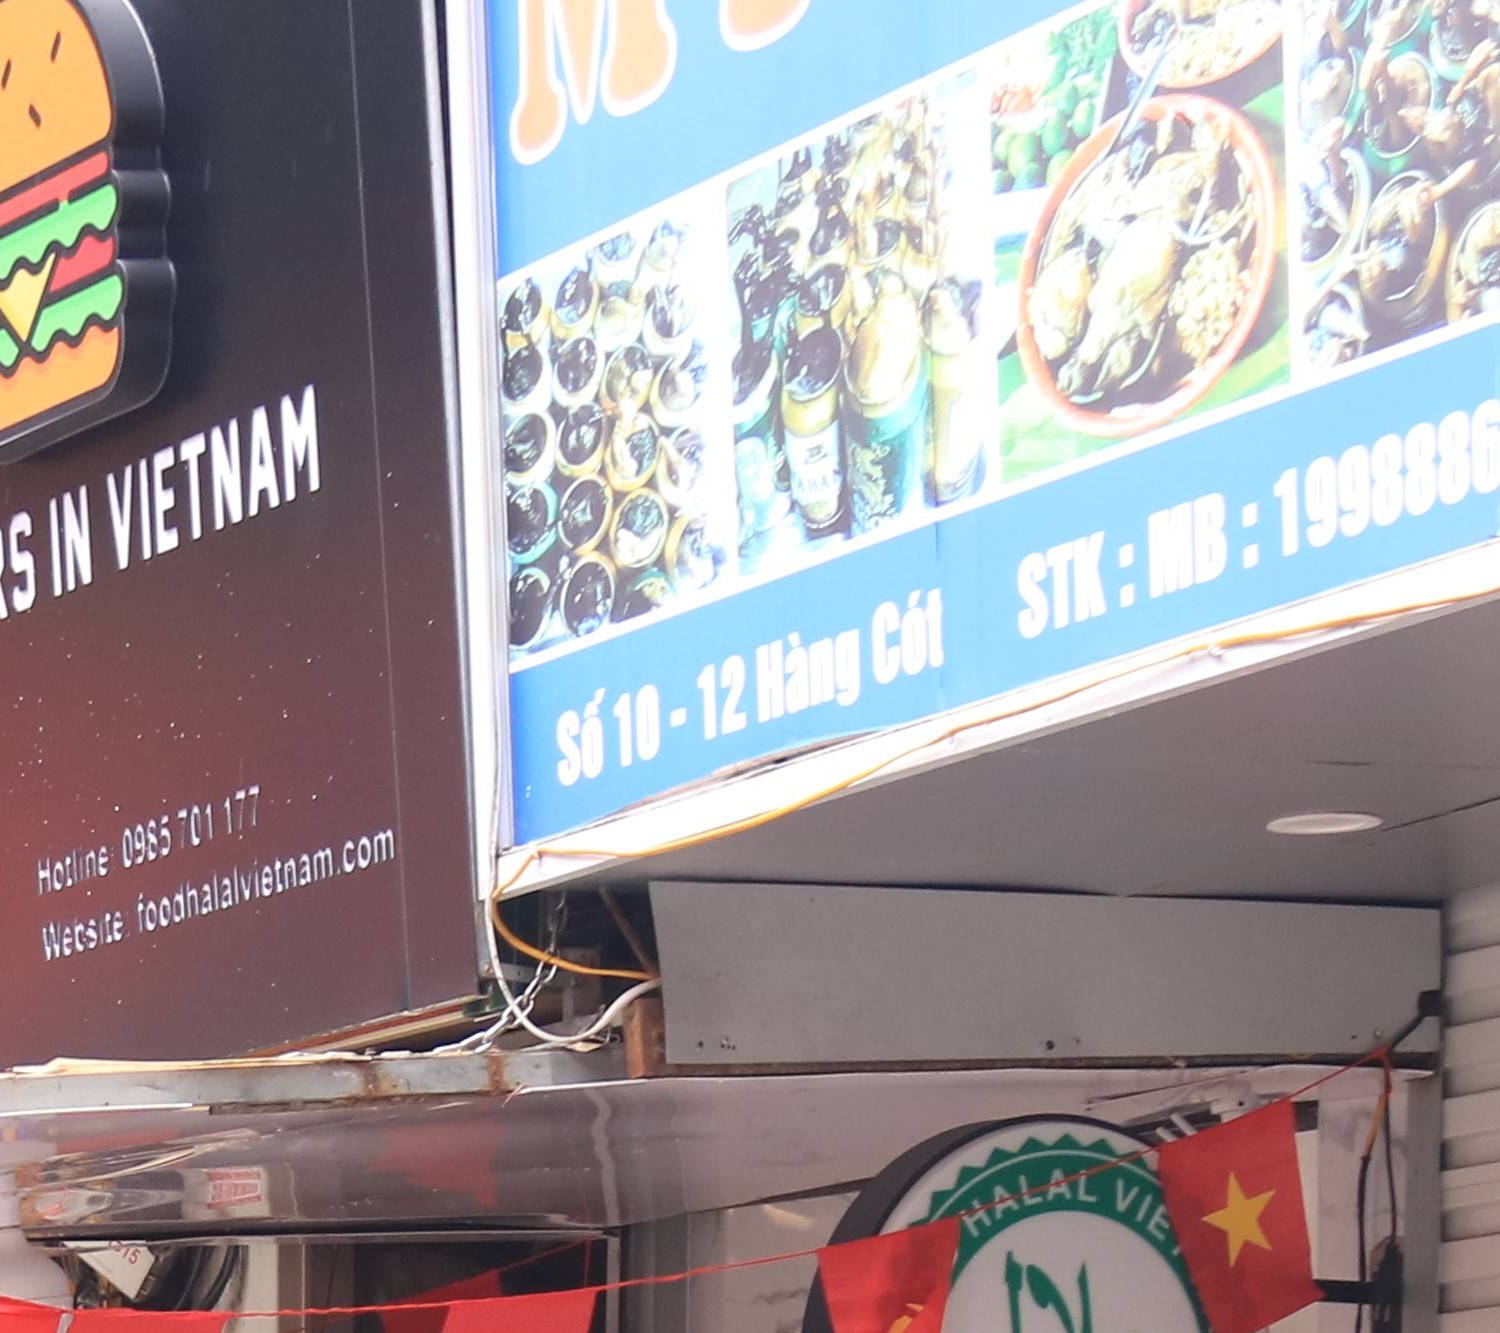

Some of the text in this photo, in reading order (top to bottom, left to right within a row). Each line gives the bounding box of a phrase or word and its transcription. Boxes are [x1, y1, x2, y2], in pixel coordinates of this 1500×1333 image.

[50, 483, 94, 598] IN
[107, 383, 322, 573] VIETNAM
[554, 688, 605, 788] Số
[614, 669, 660, 764] 10
[695, 650, 749, 739] 12
[754, 625, 861, 725] Hàng
[870, 588, 945, 684] Cót
[1015, 531, 1107, 641] STK
[1148, 493, 1229, 601] MB
[121, 813, 171, 869] 0985
[178, 804, 216, 854] 701
[224, 785, 263, 843] 177
[136, 826, 396, 934] foodhalalvietnam.com
[958, 1166, 1098, 1240] HALAL
